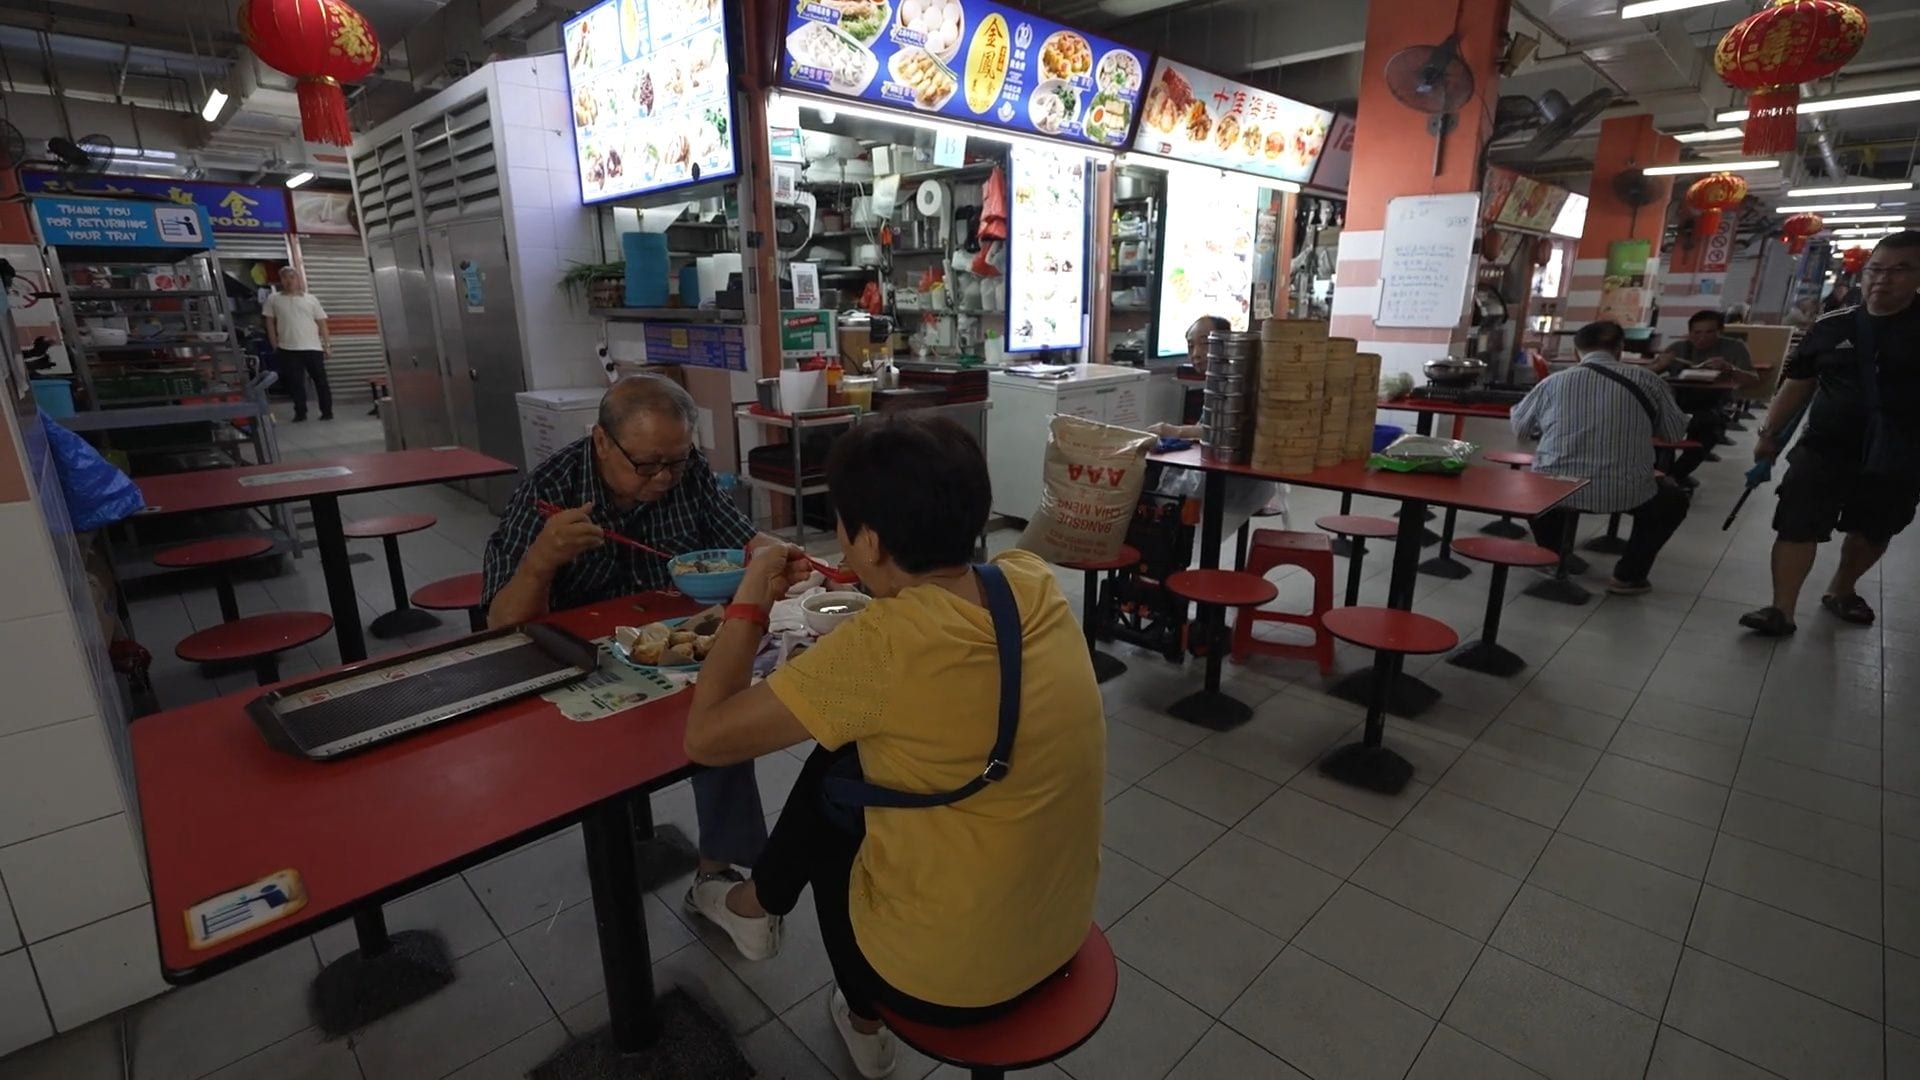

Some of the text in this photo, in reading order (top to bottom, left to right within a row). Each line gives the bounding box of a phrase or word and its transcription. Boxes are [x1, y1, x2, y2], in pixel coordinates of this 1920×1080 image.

[57, 203, 131, 216] THANK YOU
[46, 217, 148, 229] FOR RETURNING
[66, 230, 138, 241] YOUR TRAY
[1068, 464, 1125, 487] AAA
[1058, 499, 1093, 516] MENG
[1058, 513, 1112, 533] BANGSUE
[378, 721, 417, 737] diner
[422, 700, 488, 723] deserves
